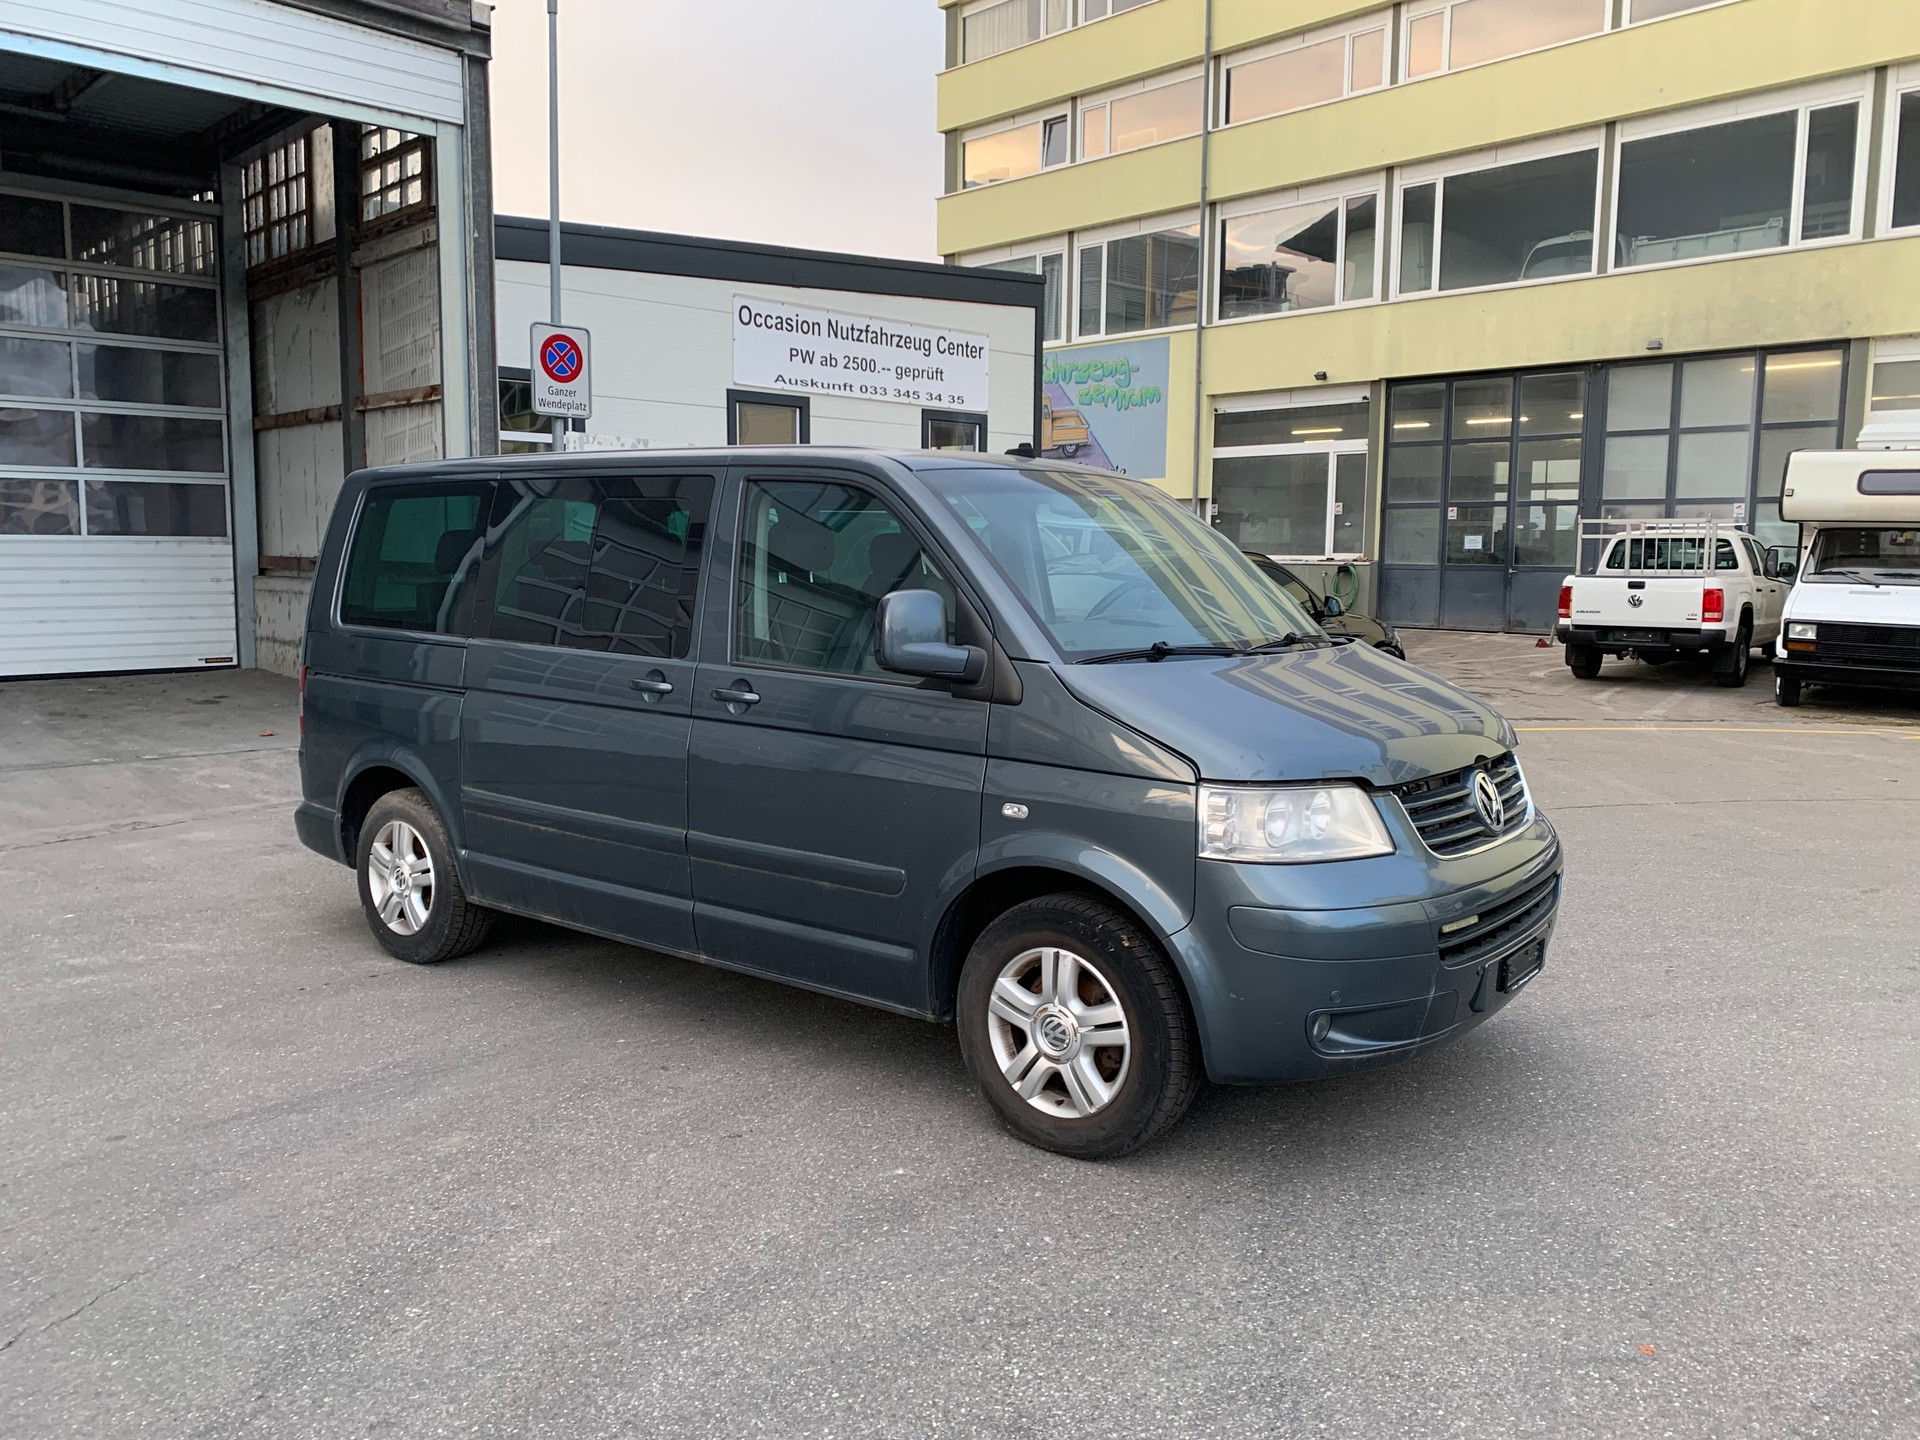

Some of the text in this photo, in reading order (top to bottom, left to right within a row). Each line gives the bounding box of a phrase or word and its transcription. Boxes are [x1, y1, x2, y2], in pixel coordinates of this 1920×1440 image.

[738, 305, 984, 359] Occasion Nutzfahrzeug Center
[789, 347, 944, 381] PW ab 2500.-- geprüft
[537, 397, 587, 412] Wendeplatz
[547, 385, 577, 398] Ganzer
[774, 374, 965, 405] Auskunft 033 345 34 35
